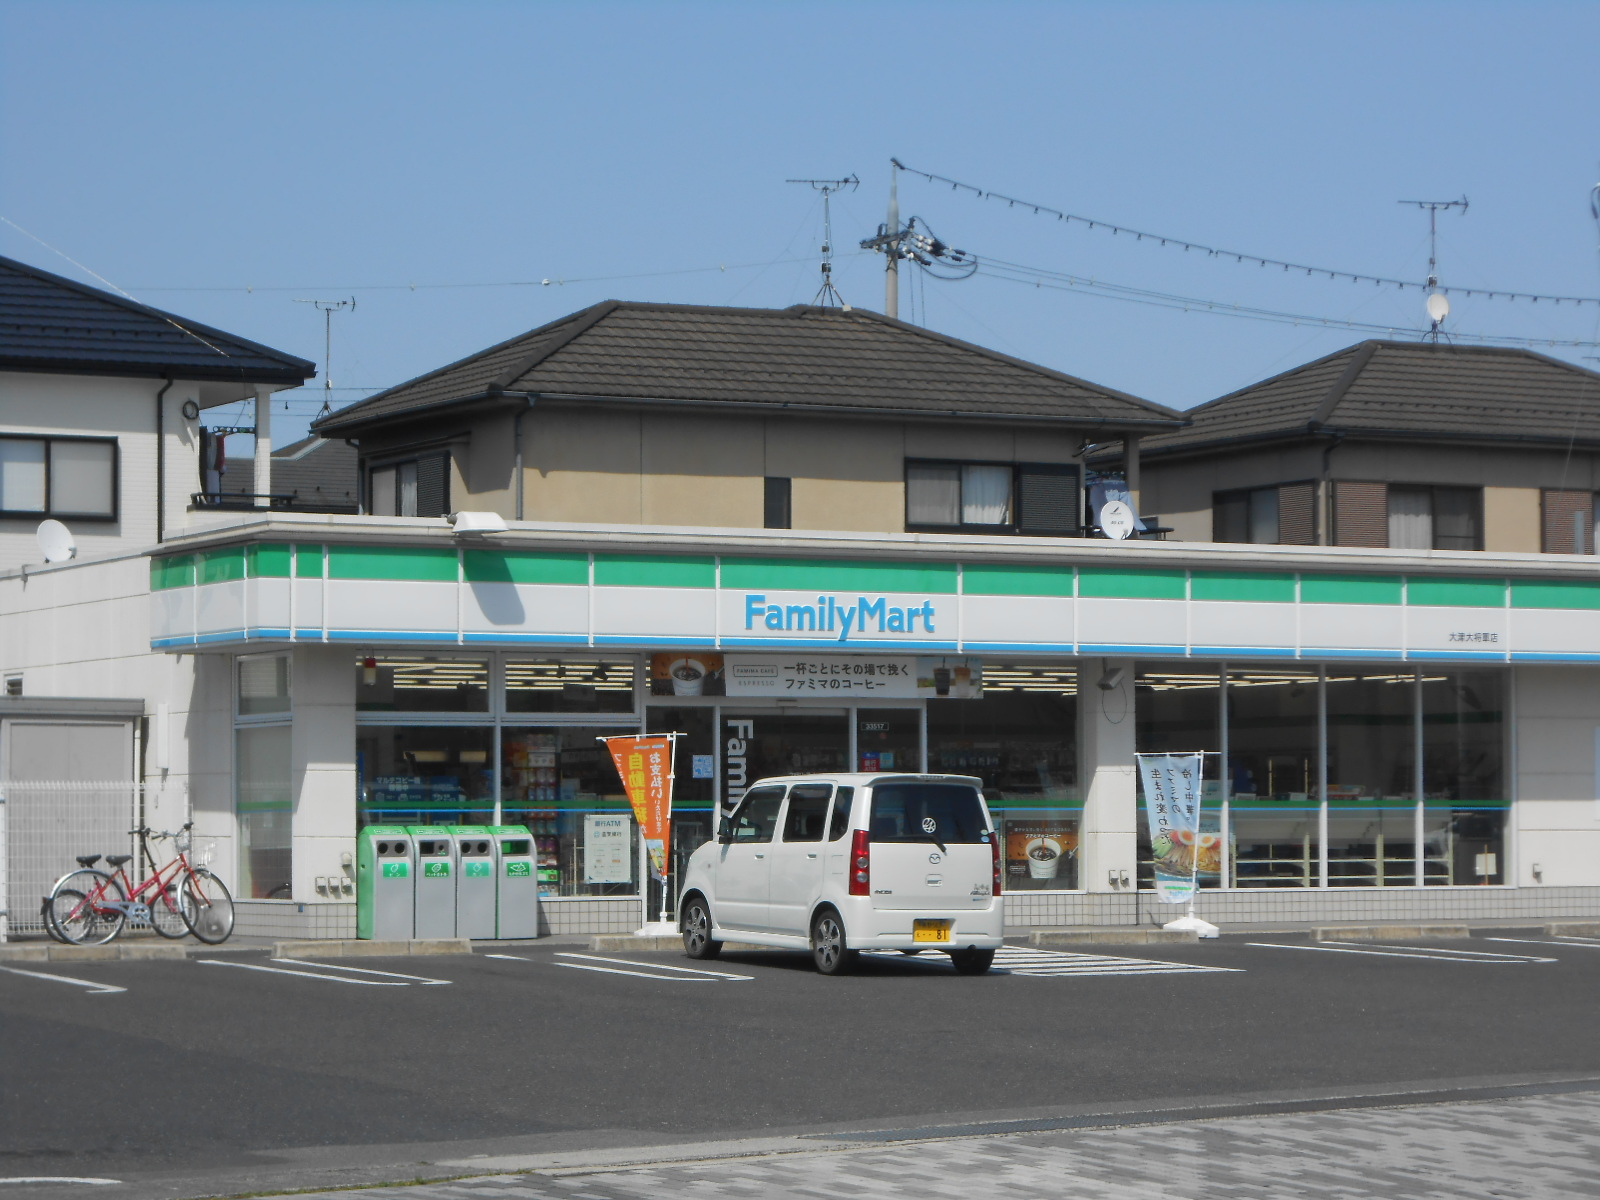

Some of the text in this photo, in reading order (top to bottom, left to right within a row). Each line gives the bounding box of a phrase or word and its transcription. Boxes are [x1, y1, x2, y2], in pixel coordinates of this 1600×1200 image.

[745, 594, 935, 641] FamilyMart
[1449, 632, 1498, 643] 大津大将軍店
[785, 662, 909, 676] 一杯ごとにその場で挽く
[785, 678, 886, 690] ファミマのコーヒー
